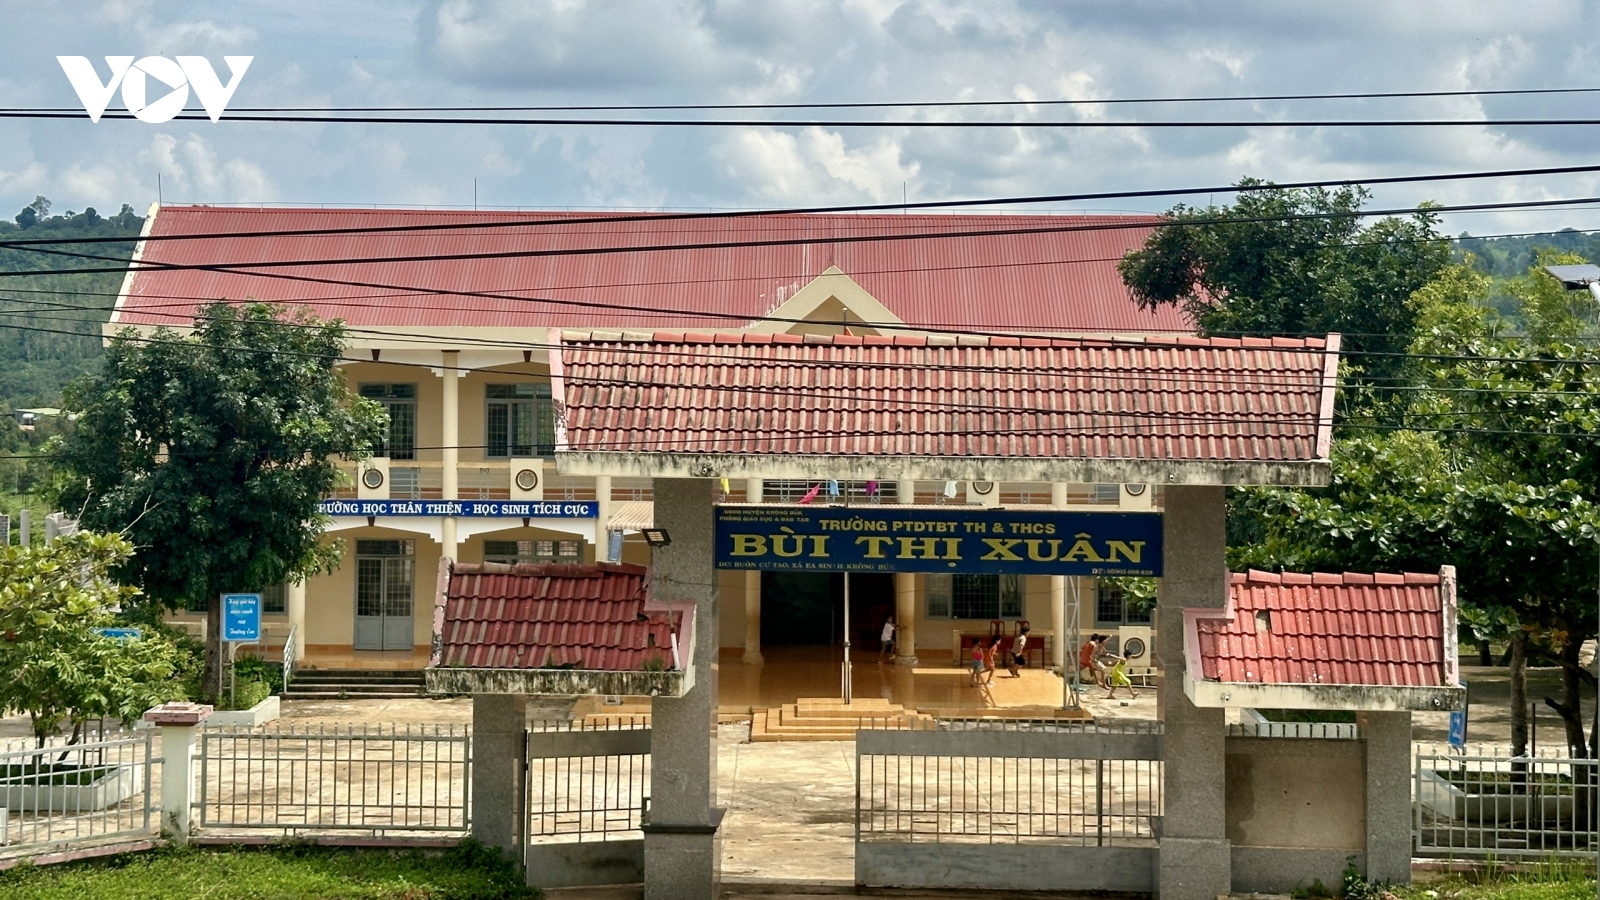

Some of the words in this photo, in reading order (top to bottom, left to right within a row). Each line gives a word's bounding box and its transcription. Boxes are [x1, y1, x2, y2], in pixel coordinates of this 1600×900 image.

[313, 501, 359, 514] RƯỜNG
[362, 503, 387, 516] HỌC
[390, 501, 422, 514] THÂN
[426, 501, 462, 516] THIỆN
[473, 503, 498, 516] HỌC
[501, 504, 530, 515] SINH
[532, 501, 561, 515] TÍCH
[564, 503, 589, 517] CỰC
[819, 515, 887, 532] TRƯỜNG
[893, 520, 958, 533] PTDTBT
[963, 521, 986, 533] TH
[992, 523, 1004, 533] &
[1010, 522, 1056, 534] THCS
[729, 526, 830, 558] BÙI
[855, 536, 963, 567] THỊ
[981, 532, 1146, 563] XUÂN
[734, 560, 757, 568] BUÔN
[846, 562, 874, 570] KRÔNG
